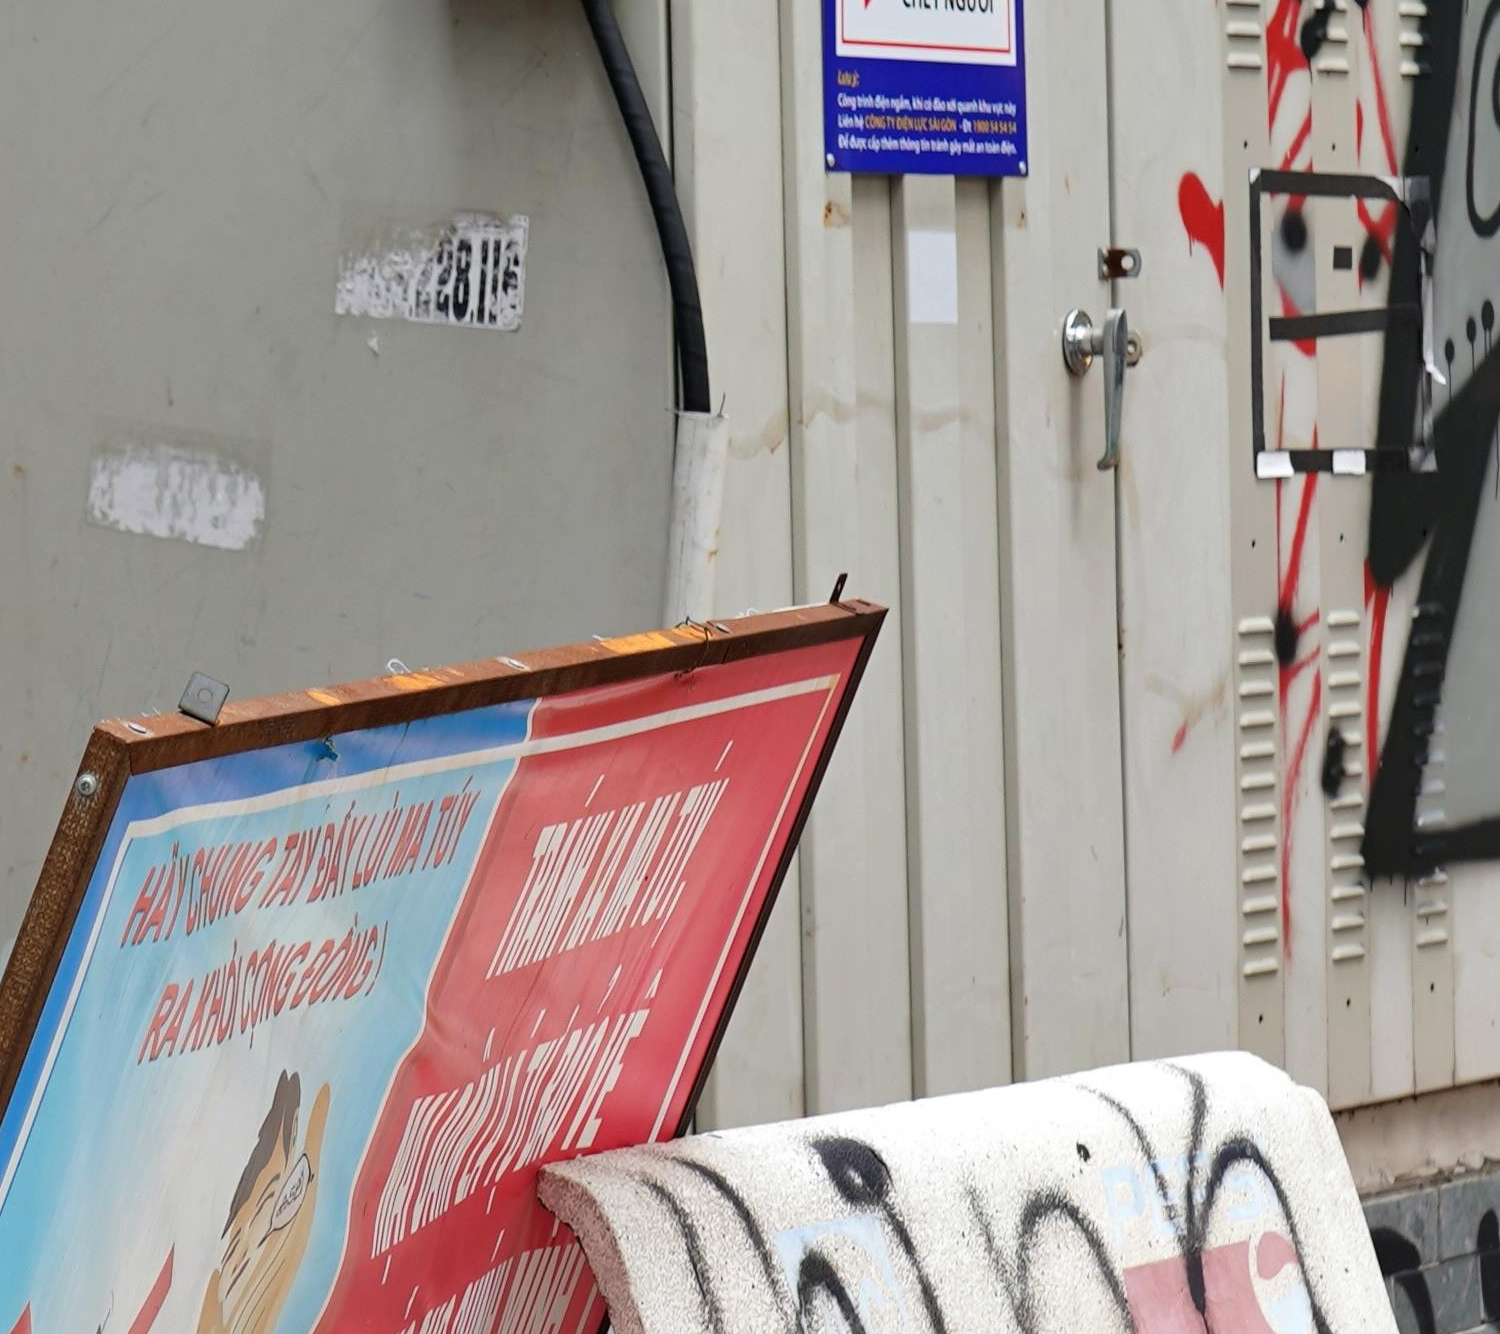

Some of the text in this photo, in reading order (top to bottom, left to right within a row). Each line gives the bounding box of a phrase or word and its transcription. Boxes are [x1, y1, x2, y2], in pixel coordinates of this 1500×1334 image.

[121, 841, 190, 946] HÃY
[185, 837, 279, 935] CHUNG
[259, 826, 323, 907] TAY
[306, 799, 377, 903] ĐẨY
[384, 802, 434, 877] MA
[424, 775, 481, 868] TÚY
[484, 774, 616, 980] TRÁNH
[557, 801, 646, 955] XA
[586, 791, 682, 946] MA
[138, 980, 195, 1064] RA
[180, 940, 249, 1054] KHỎI
[239, 939, 313, 1048] CỘNG
[514, 964, 622, 1171] BẢO
